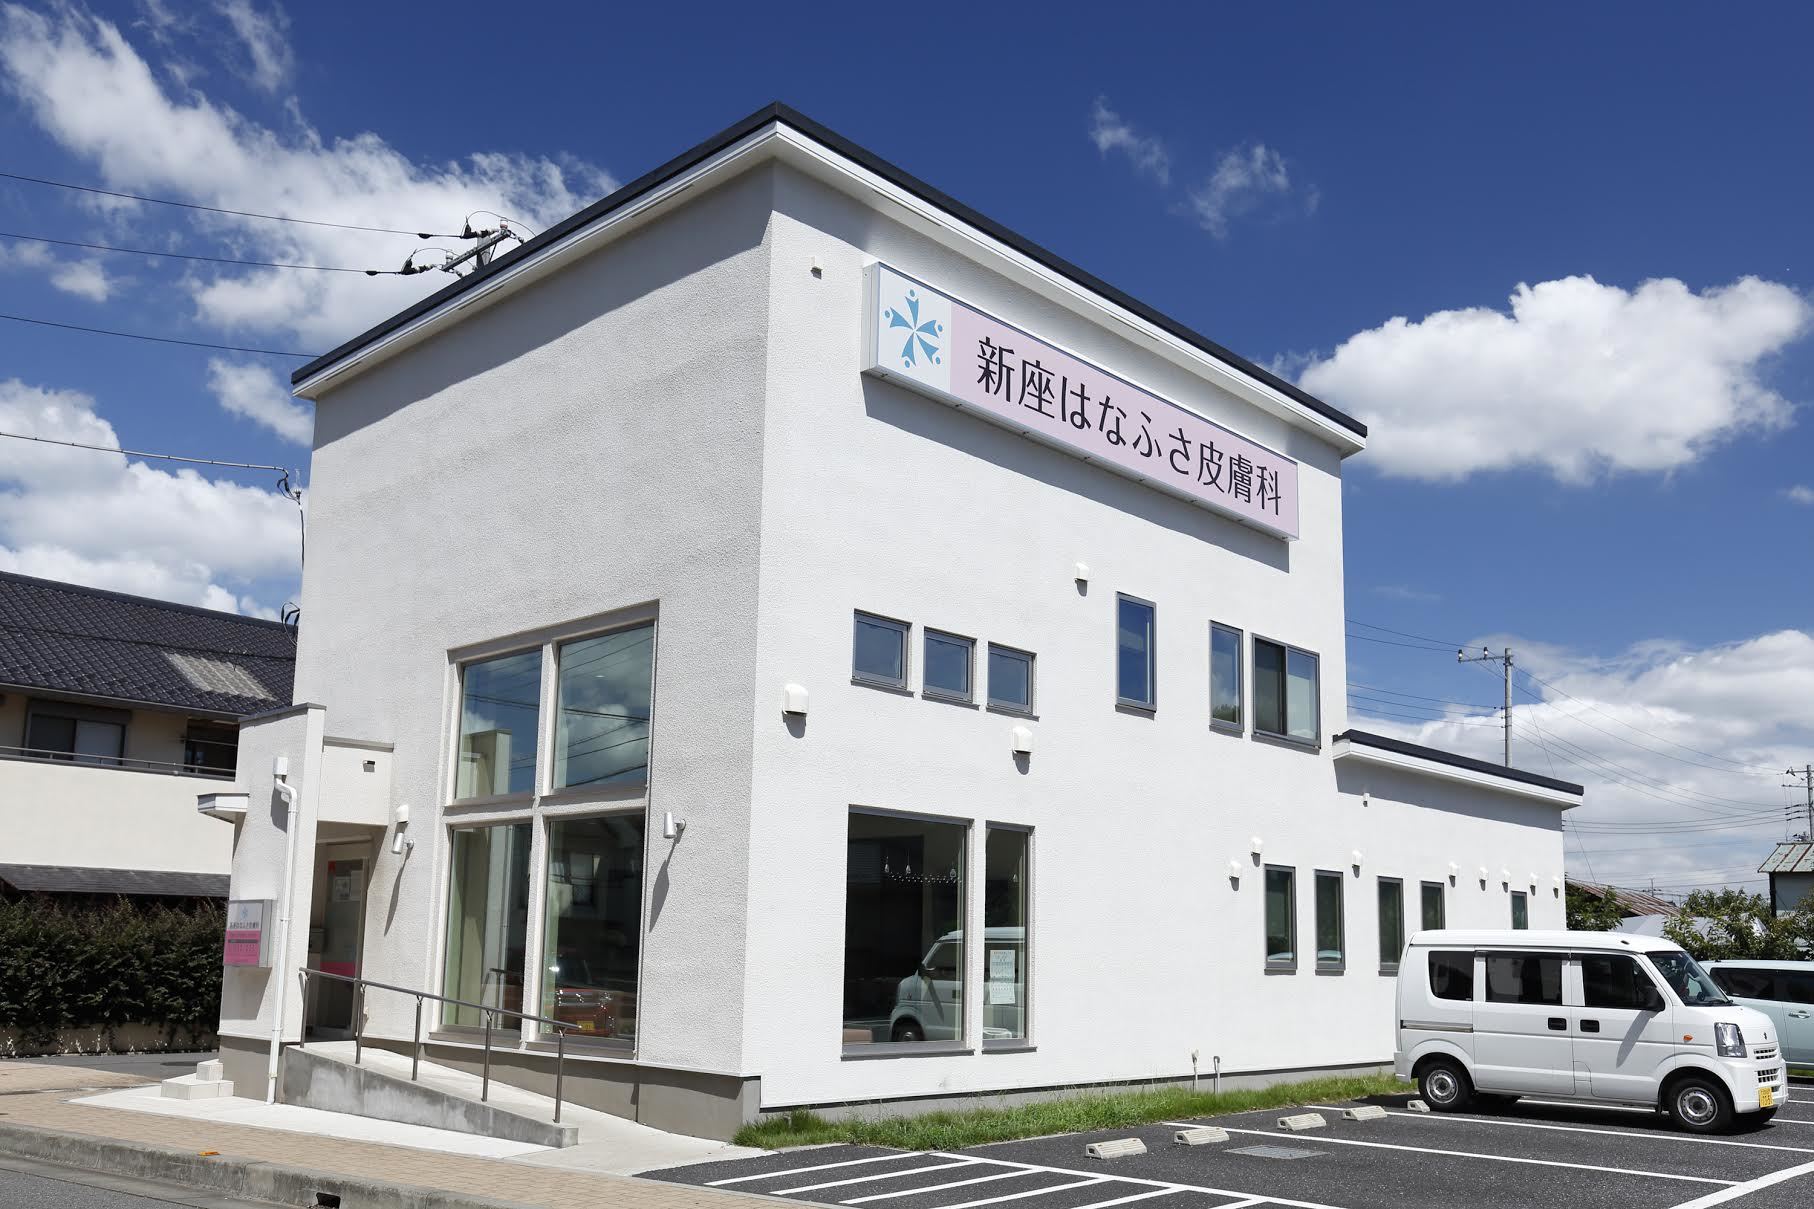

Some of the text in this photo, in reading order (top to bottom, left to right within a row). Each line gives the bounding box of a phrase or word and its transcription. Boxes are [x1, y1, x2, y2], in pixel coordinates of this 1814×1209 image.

[976, 335, 1282, 516] 新座はなふさ皮膚科
